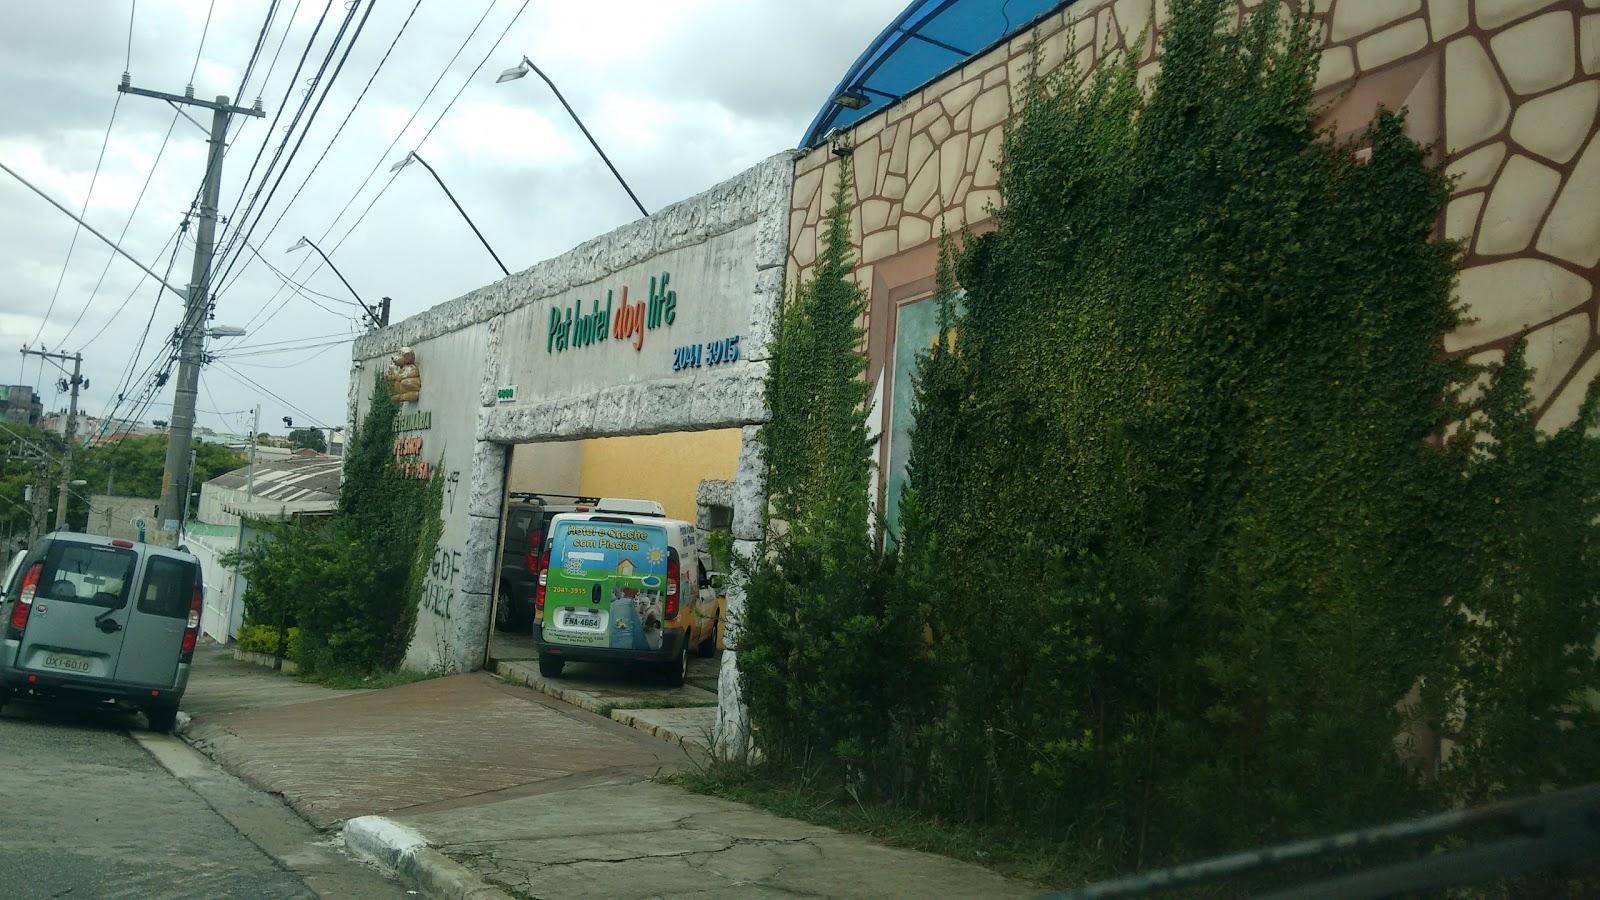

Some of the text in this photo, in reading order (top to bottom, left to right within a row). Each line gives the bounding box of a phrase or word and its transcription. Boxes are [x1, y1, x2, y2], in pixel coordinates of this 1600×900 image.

[547, 271, 677, 353] Pet hotel dog life
[672, 335, 740, 371] 2041 3915
[567, 526, 596, 537] Hotel
[607, 528, 648, 540] Creche
[572, 540, 639, 552] com Piscina
